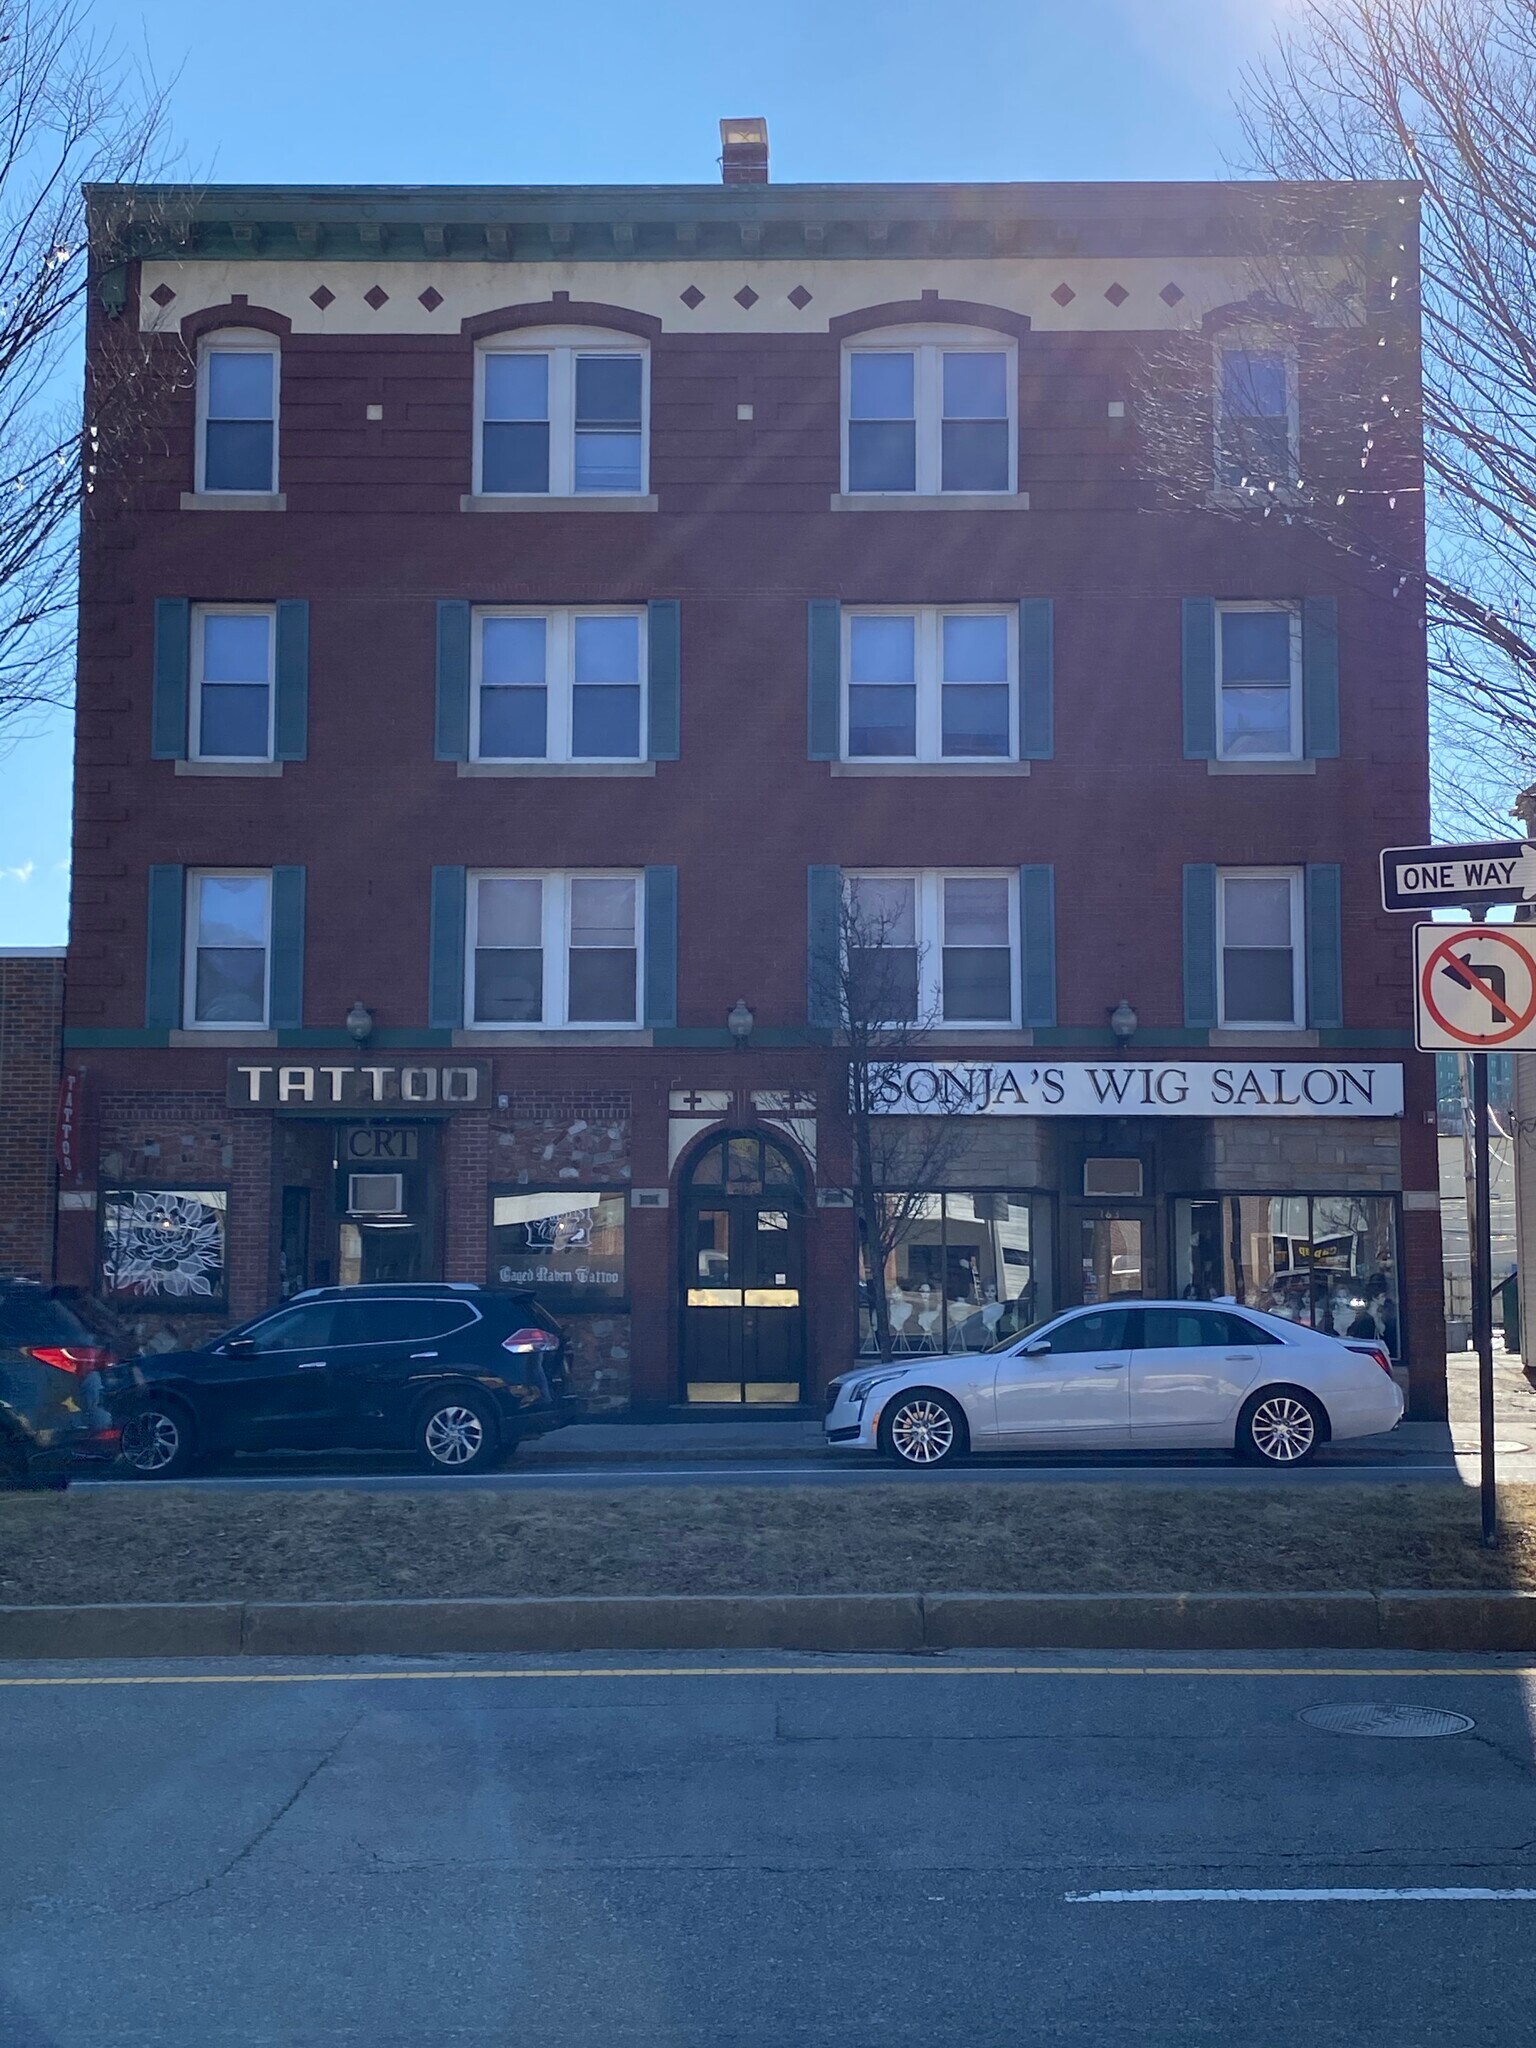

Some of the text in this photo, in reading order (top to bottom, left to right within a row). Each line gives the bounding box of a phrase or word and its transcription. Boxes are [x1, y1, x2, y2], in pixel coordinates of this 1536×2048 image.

[1403, 861, 1517, 890] ONE WAY
[237, 1066, 479, 1103] TATTOO
[880, 1066, 1376, 1111] SONJA'S WIG SALON
[61, 1075, 76, 1171] TATTOO
[349, 1129, 416, 1157] CRT
[575, 1265, 619, 1283] Tattoo
